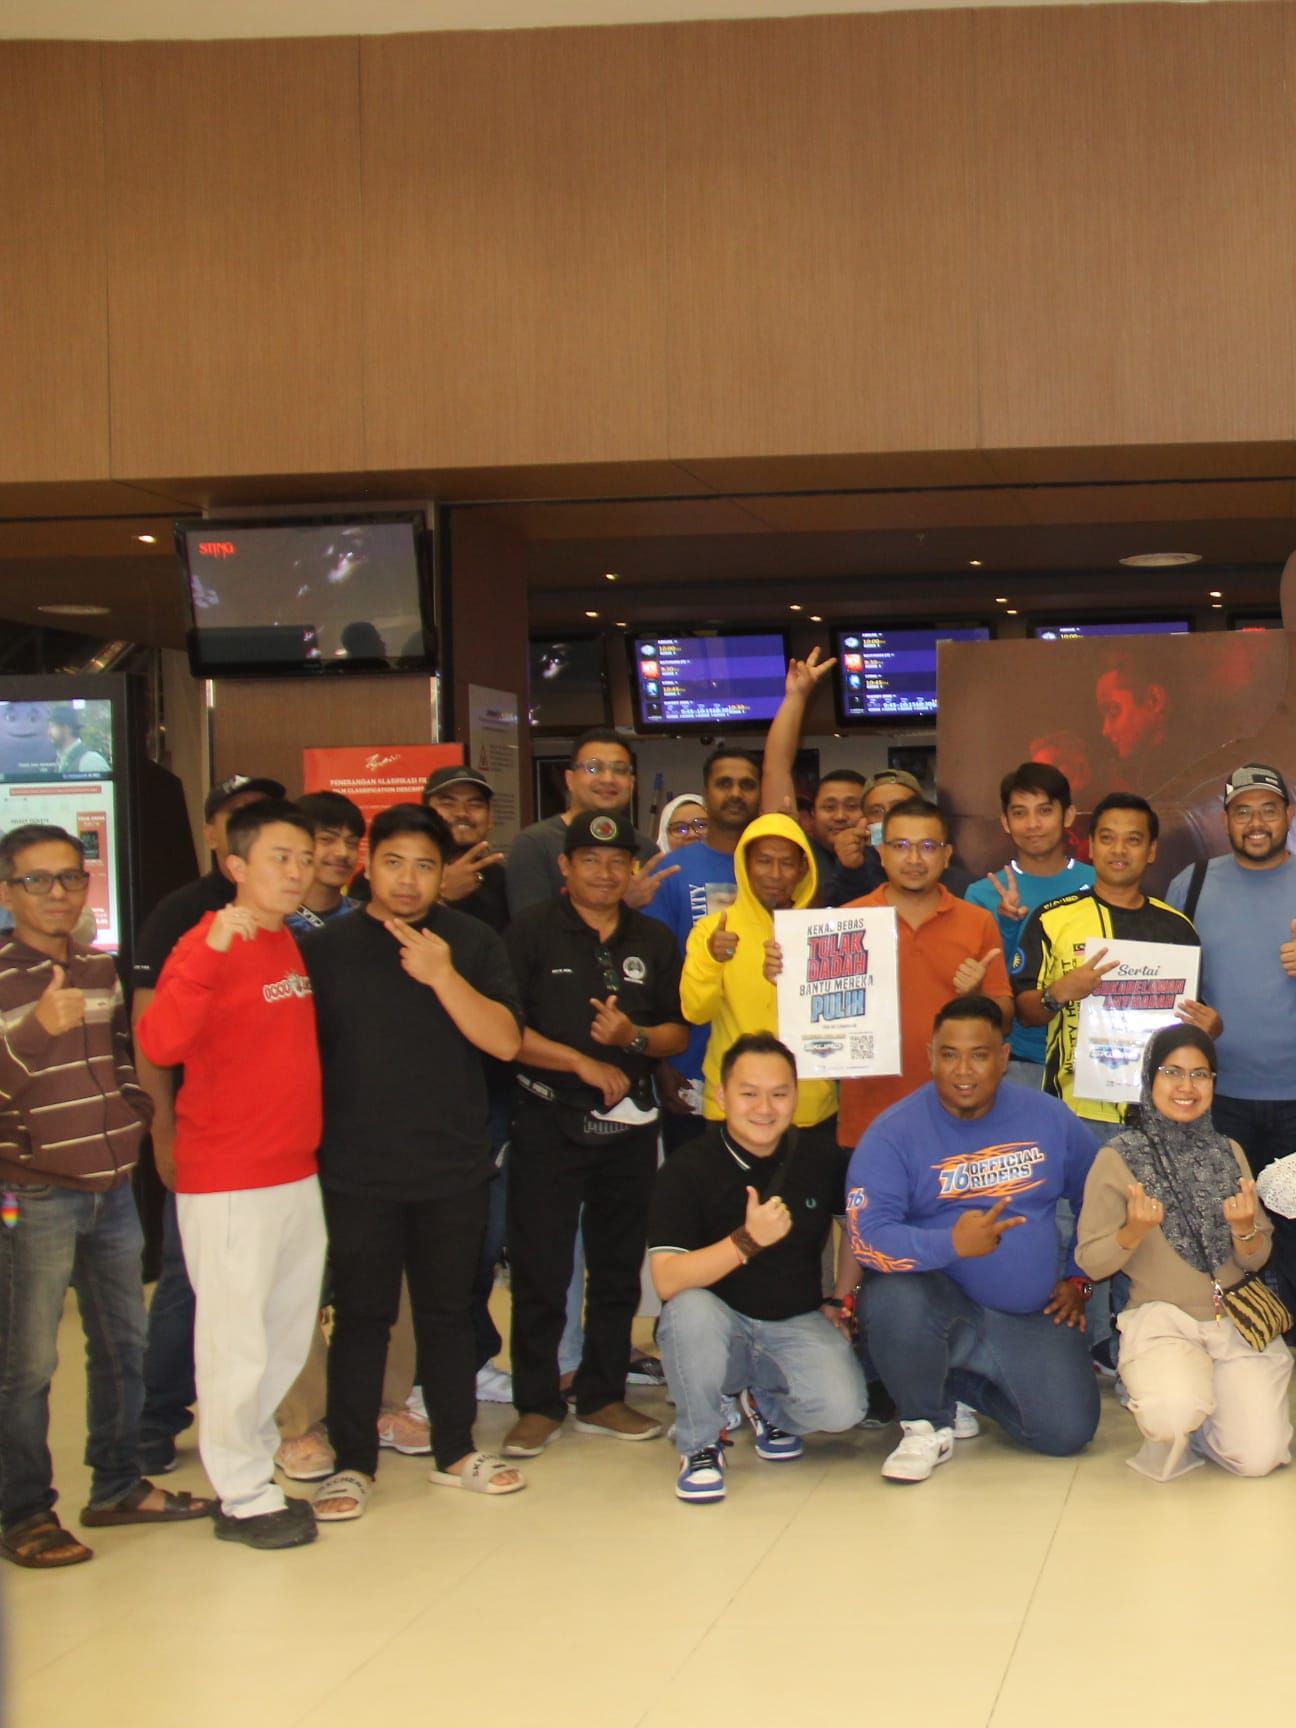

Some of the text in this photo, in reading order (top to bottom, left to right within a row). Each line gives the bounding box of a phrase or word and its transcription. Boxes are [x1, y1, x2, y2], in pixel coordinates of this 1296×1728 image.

[837, 918, 864, 930] BEBAS
[807, 951, 868, 982] DADAH
[1117, 964, 1161, 977] Sertai
[799, 975, 874, 996] BANTU MEREKA
[810, 988, 866, 1023] PULIH
[940, 1147, 1044, 1194] 76 OFFICIAL
[970, 1163, 1032, 1189] RIDERS
